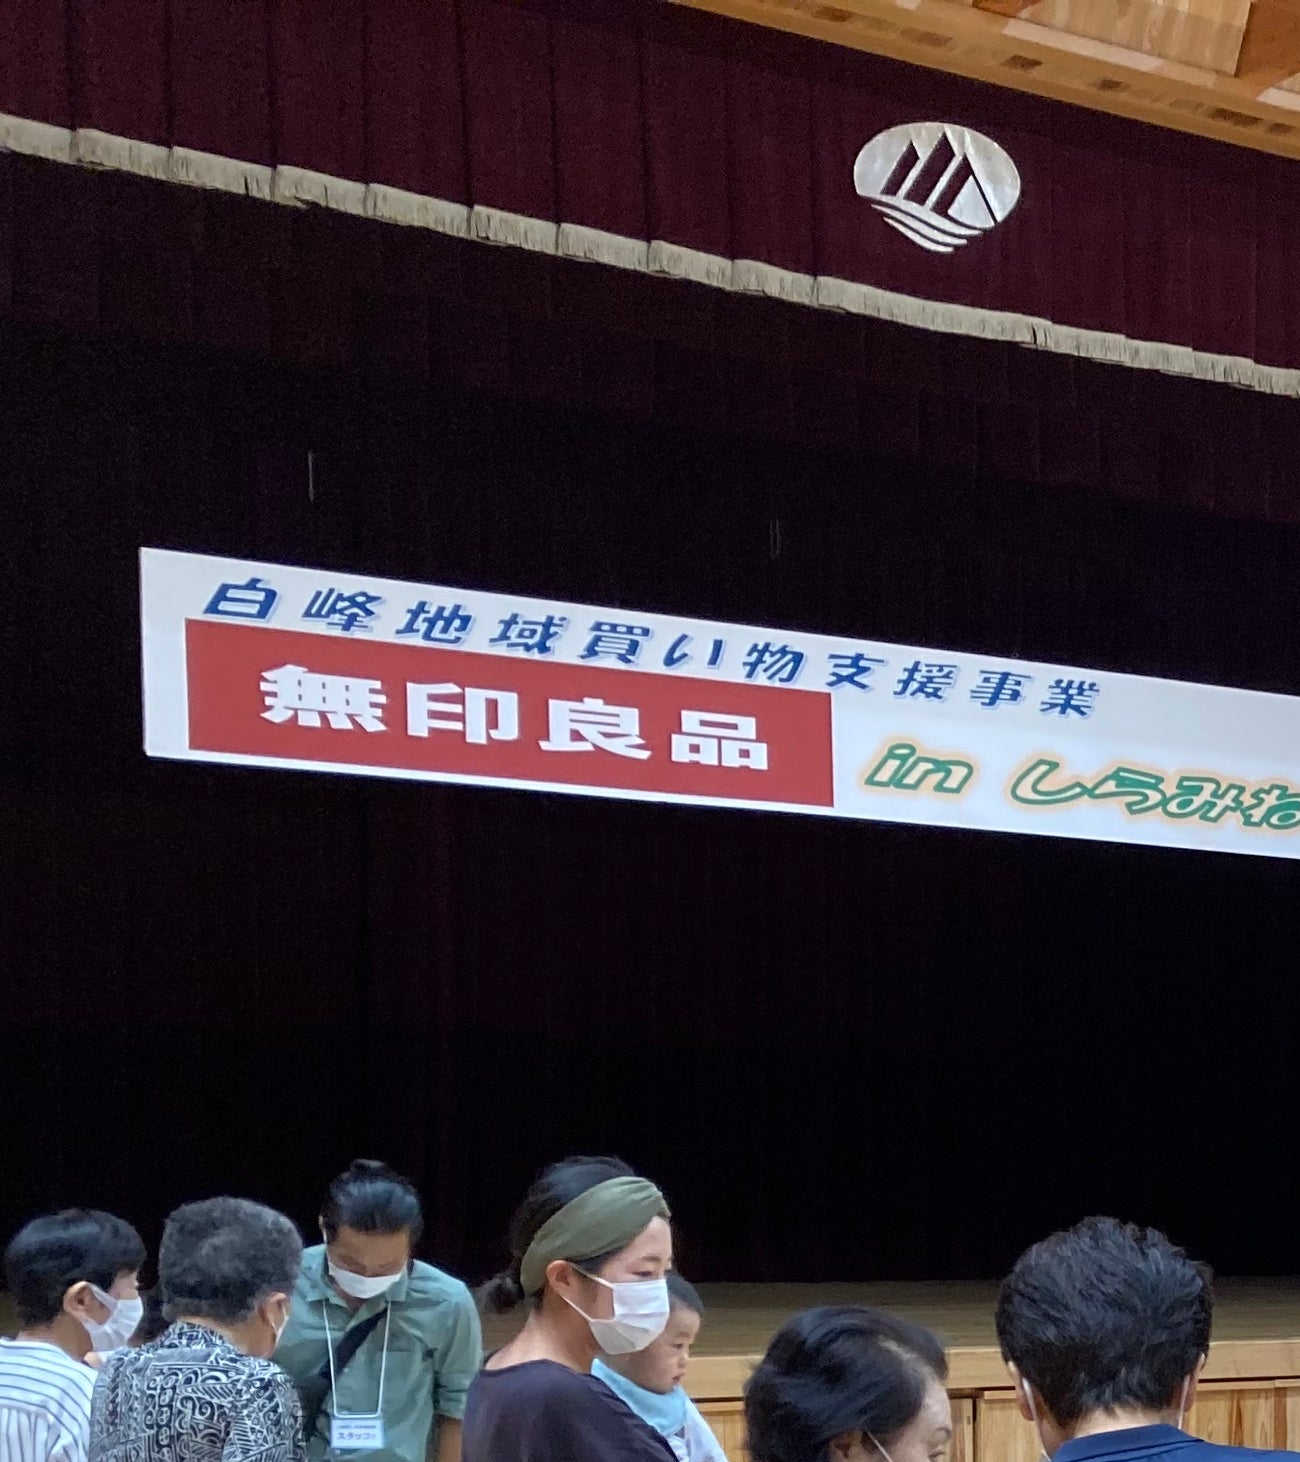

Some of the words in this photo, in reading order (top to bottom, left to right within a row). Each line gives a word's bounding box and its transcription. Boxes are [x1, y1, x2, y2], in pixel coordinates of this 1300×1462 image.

[203, 578, 1099, 716] 白峰地域買い物支援事業
[260, 663, 768, 769] 無印良品
[865, 743, 973, 793] in
